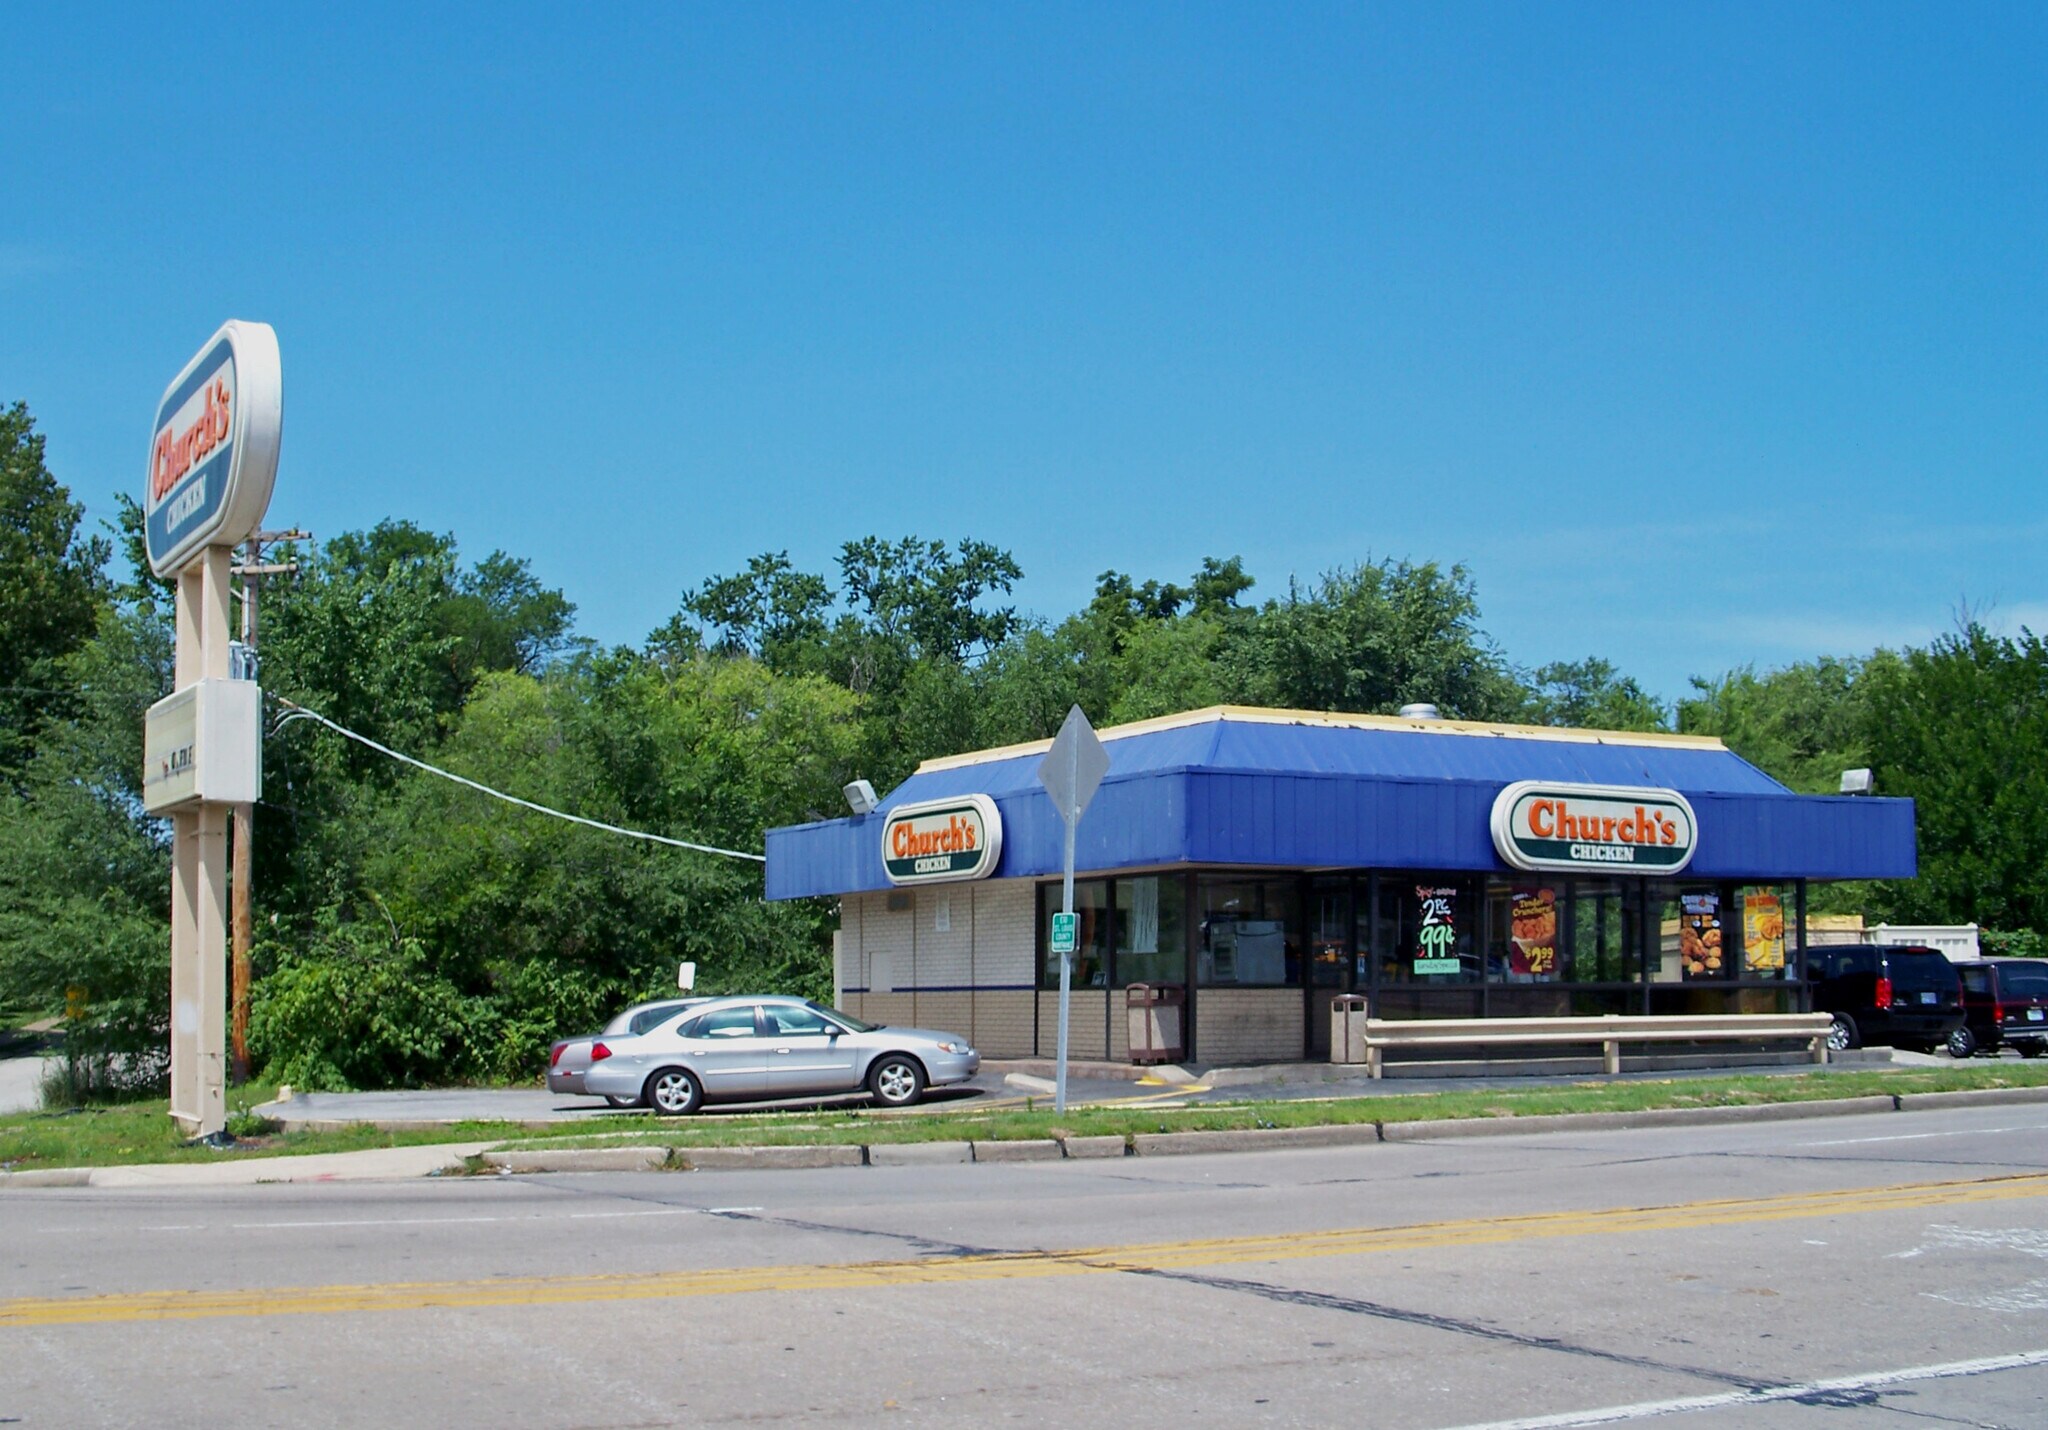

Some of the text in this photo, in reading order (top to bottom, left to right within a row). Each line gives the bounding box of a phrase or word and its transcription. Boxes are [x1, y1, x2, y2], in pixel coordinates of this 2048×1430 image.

[152, 376, 230, 500] Church's
[167, 473, 206, 534] CHICKEN
[892, 815, 976, 857] Church's
[1528, 799, 1676, 845] Church's
[915, 855, 951, 874] CHICKEN
[1570, 844, 1635, 862] CHICKEN
[1420, 925, 1455, 958] 99¢
